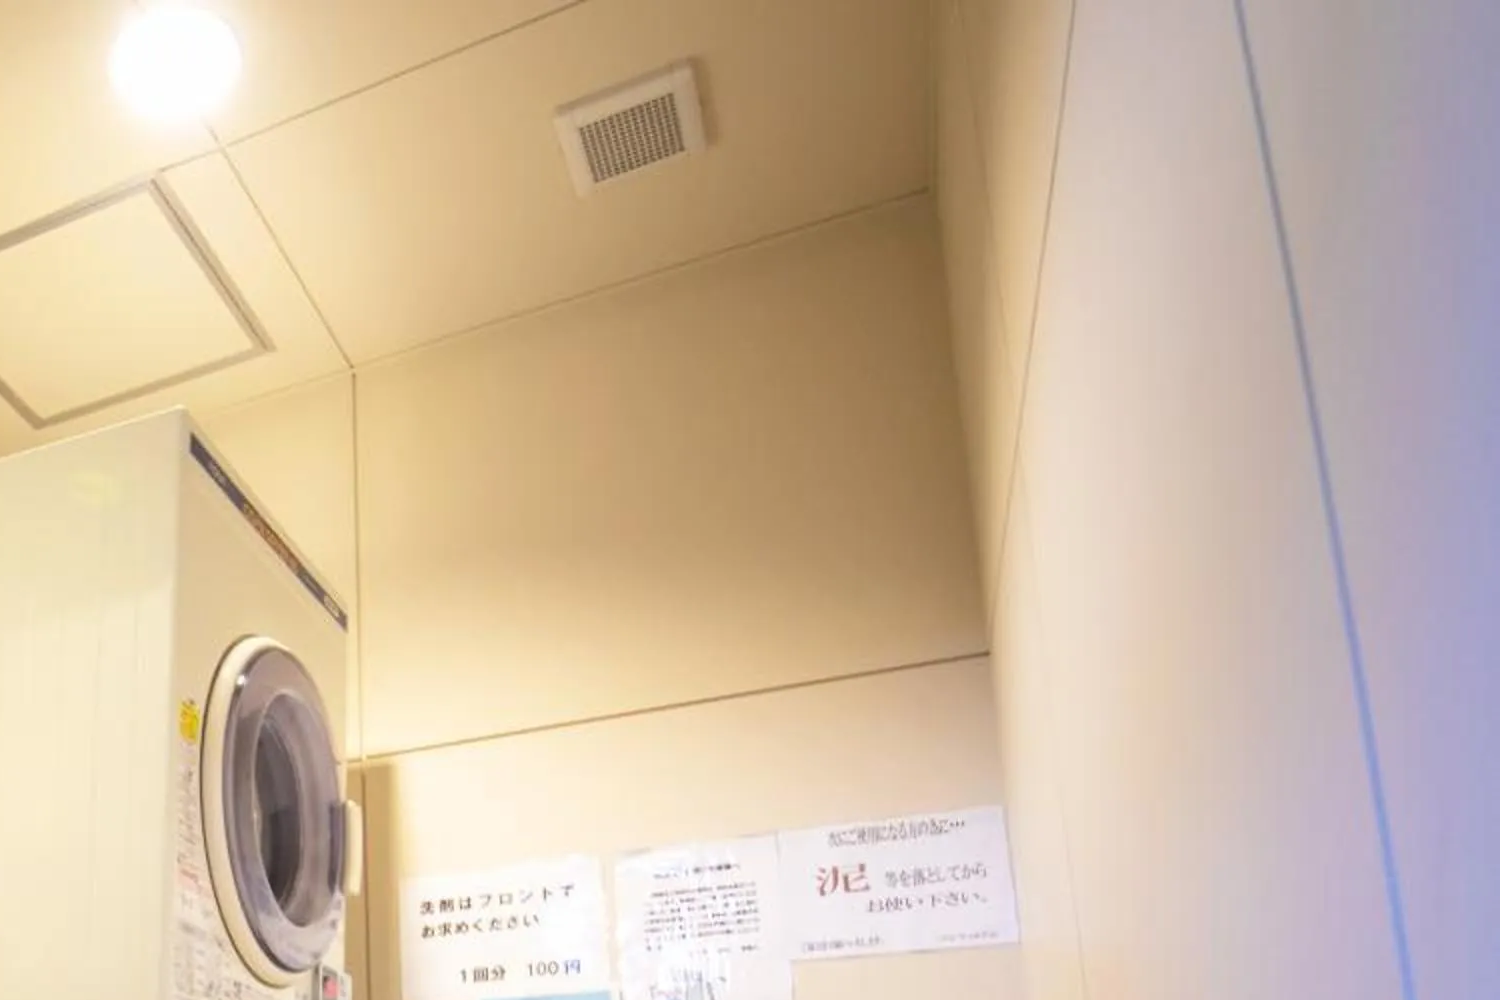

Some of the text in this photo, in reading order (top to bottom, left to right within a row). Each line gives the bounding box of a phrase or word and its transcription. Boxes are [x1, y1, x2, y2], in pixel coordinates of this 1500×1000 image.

[816, 863, 870, 897] 泥
[420, 883, 575, 916] 洗剤はフロントで
[421, 913, 540, 940] お求めください
[528, 959, 581, 977] 100円
